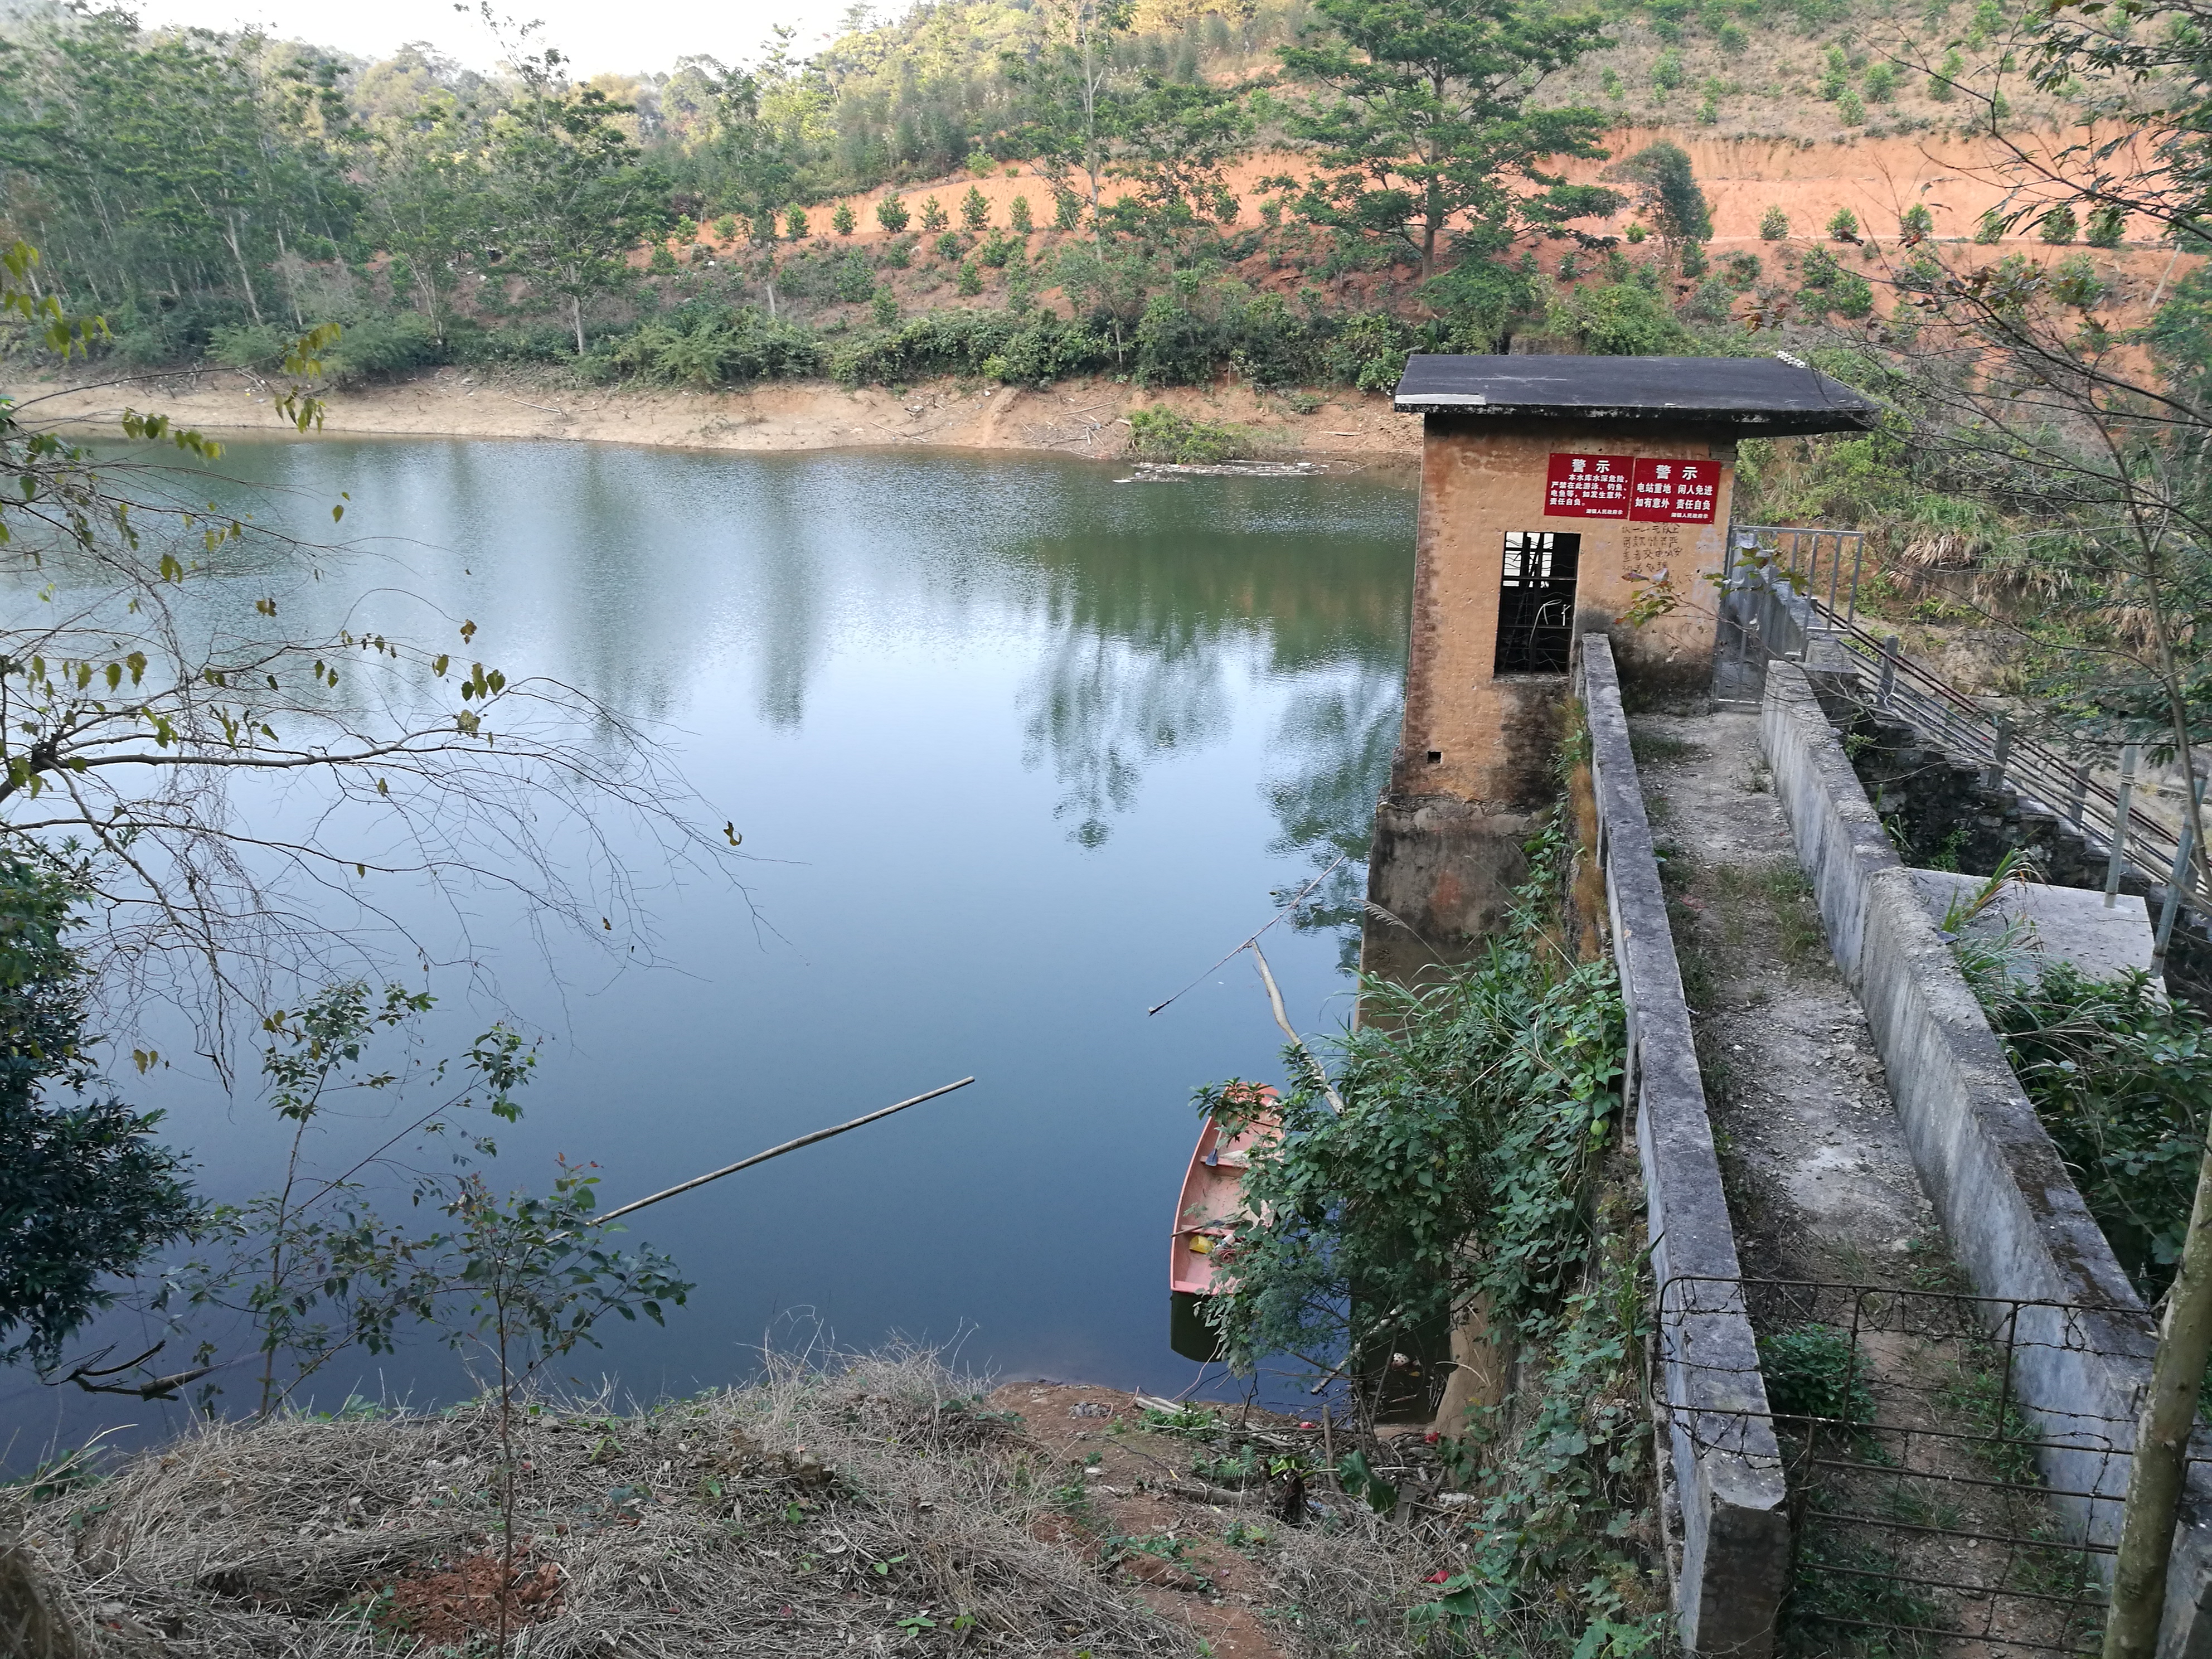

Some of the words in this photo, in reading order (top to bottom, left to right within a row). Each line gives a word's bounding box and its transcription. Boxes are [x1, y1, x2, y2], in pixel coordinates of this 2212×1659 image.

[1637, 483, 1671, 494] 电站重地
[1677, 484, 1713, 496] 闲人免进
[1634, 497, 1670, 508] 如有意外
[1676, 499, 1710, 510] 责任自负
